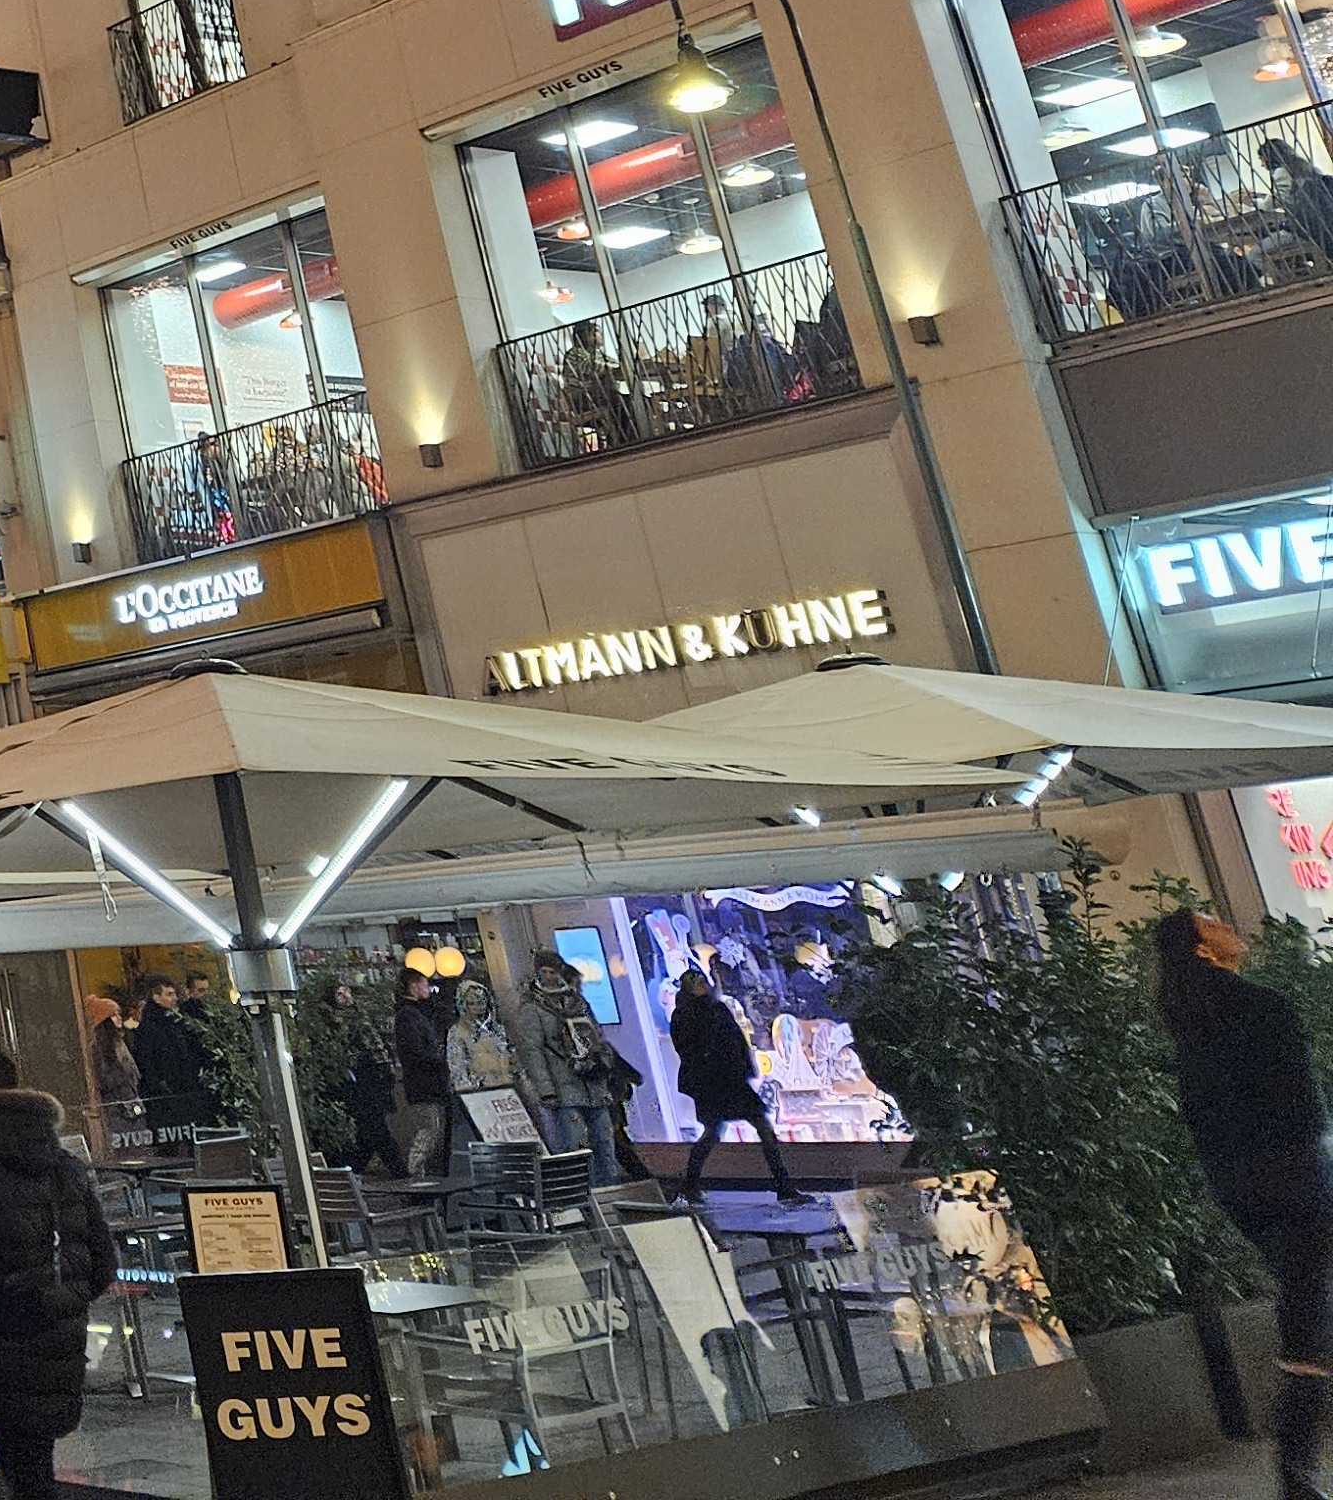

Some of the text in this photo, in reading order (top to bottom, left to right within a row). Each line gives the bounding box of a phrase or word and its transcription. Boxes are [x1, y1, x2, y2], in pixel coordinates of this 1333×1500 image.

[538, 60, 623, 98] FIVE GUYS
[1138, 515, 1333, 608] FIVE
[115, 566, 264, 624] L'OCCITANE
[483, 589, 895, 696] ALTMANN & KÜHNE
[204, 1197, 264, 1206] FIVE GUYS
[221, 1328, 348, 1372] FIVE
[217, 1393, 371, 1441] GUYS
